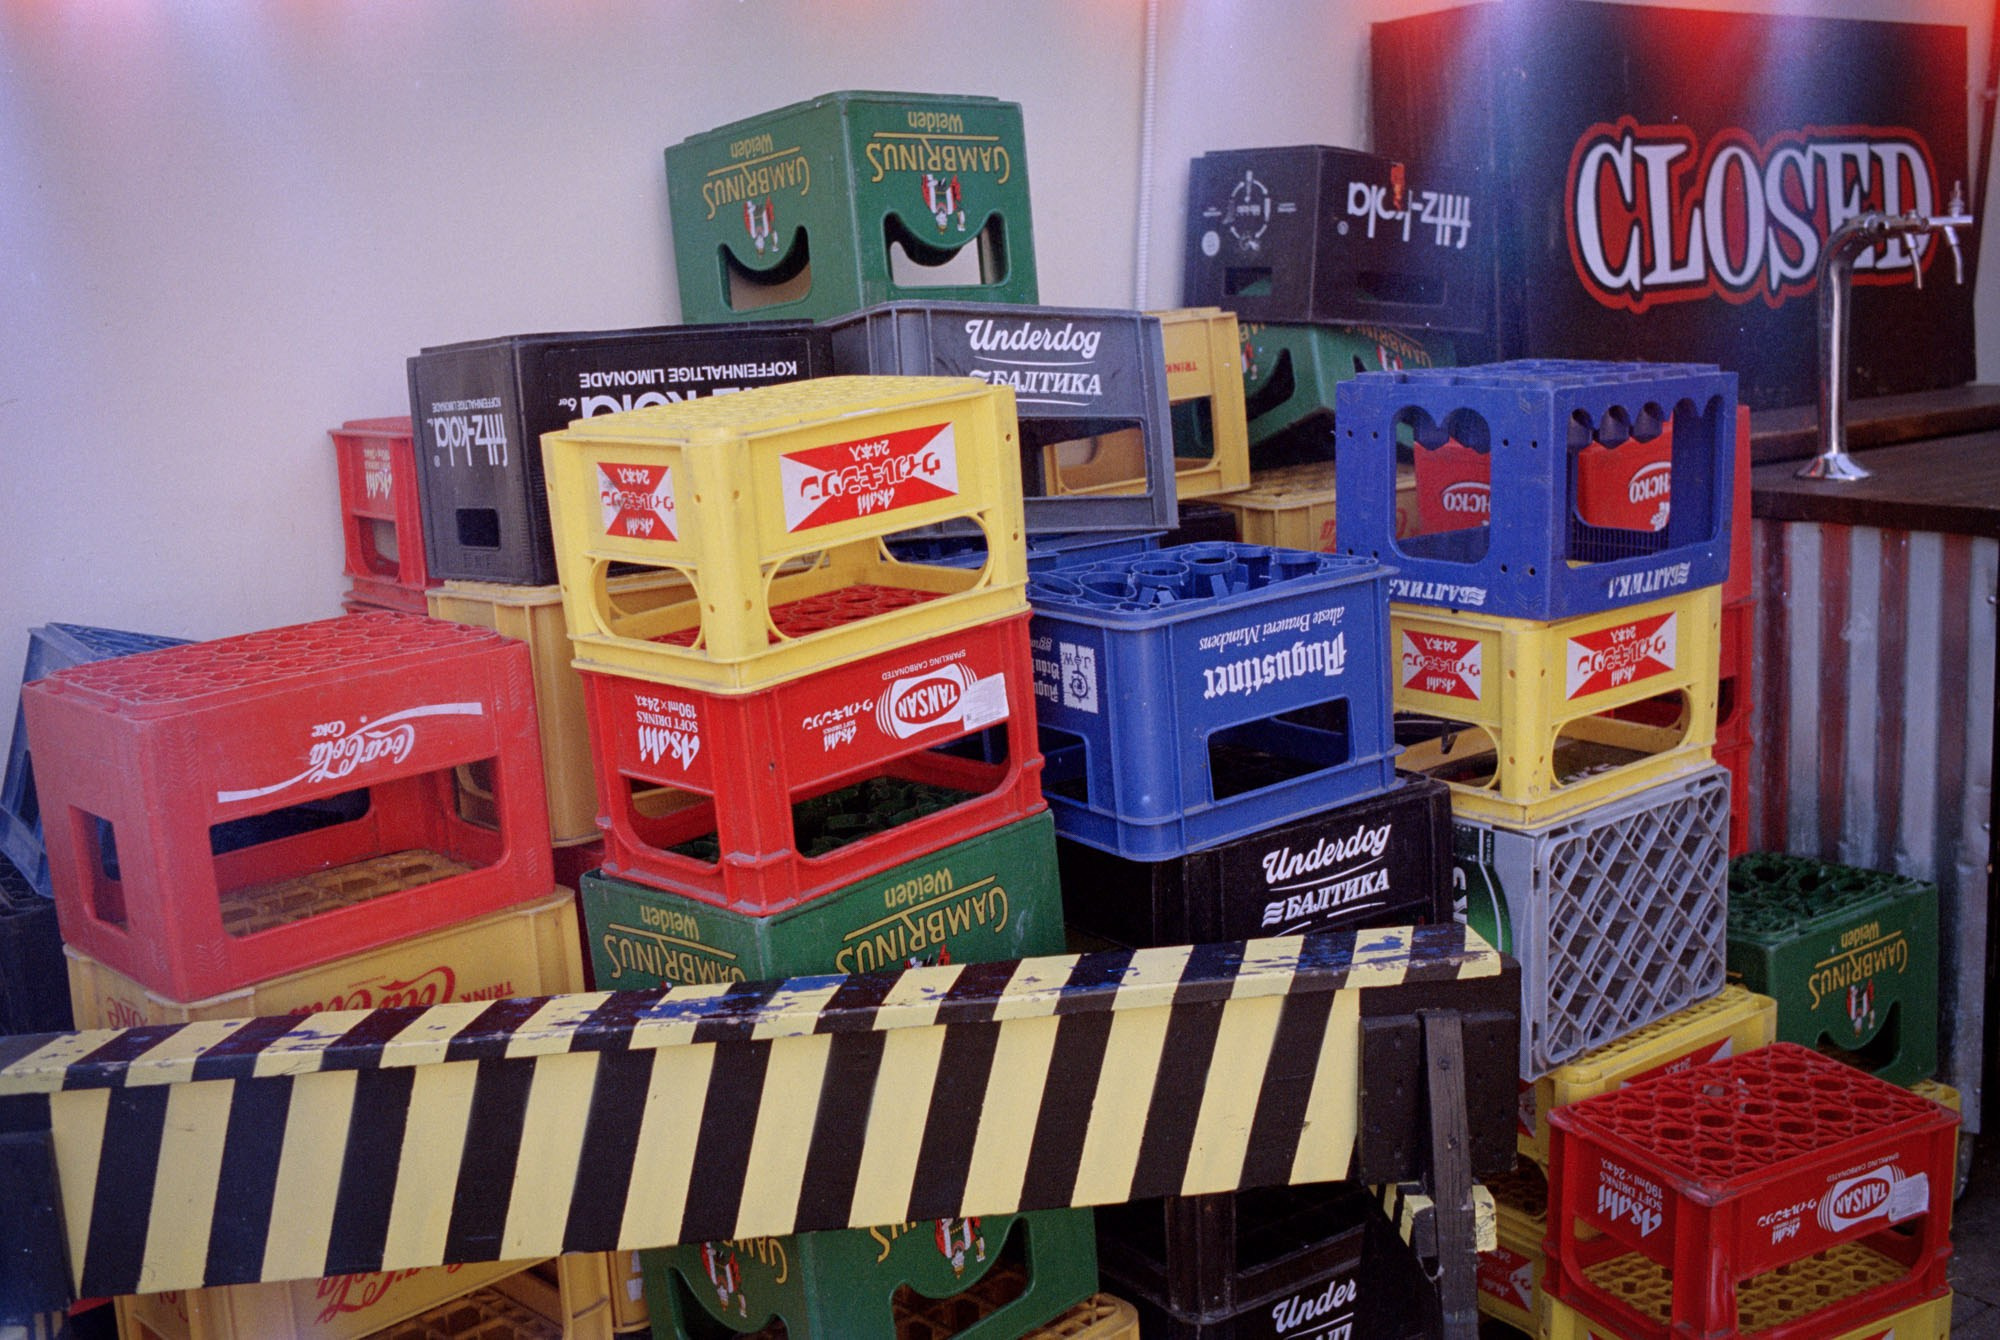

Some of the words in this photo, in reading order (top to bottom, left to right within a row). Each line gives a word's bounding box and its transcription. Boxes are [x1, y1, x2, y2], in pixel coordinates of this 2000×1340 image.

[908, 112, 963, 133] Weiden
[730, 133, 773, 159] Weiden
[866, 137, 1010, 184] GAMBRINUS
[703, 156, 810, 221] GAMBRINUS
[1577, 136, 1932, 292] CLOSED
[965, 319, 1101, 359] Underdog
[579, 367, 664, 388] LIMONADE
[668, 361, 797, 383] KOFFEINHALTIGE
[992, 370, 1103, 395] БАЛТИКА
[434, 413, 508, 468] fritz-kola
[849, 440, 890, 461] 24本入
[857, 487, 895, 516] Asahi
[625, 517, 654, 537] Asahi
[1262, 613, 1311, 643] Brauerei
[881, 661, 929, 680] CARBONATED
[929, 649, 966, 667] SPARKLING
[1203, 631, 1347, 700] Augustiner
[1426, 676, 1456, 693] Asahi
[897, 684, 958, 718] TANSAN
[636, 711, 672, 729] DRINKS
[674, 718, 699, 733] SOFT
[307, 723, 415, 783] Coca-Cola
[638, 725, 700, 771] Asahi
[823, 726, 857, 752] Asahi
[1262, 823, 1392, 884] Underdog
[884, 867, 953, 909] Weiden
[1284, 868, 1390, 921] БАЛТИКА
[640, 905, 699, 941] Weiden
[1841, 921, 1880, 948] Weiden
[1808, 938, 1908, 1011] GAMBRINUS
[1600, 1171, 1635, 1198] DRINKS
[1835, 1182, 1886, 1214] TANSAN
[1598, 1184, 1662, 1238] Asahi
[1638, 1191, 1662, 1211] SOFT
[1772, 1220, 1800, 1245] Asahi
